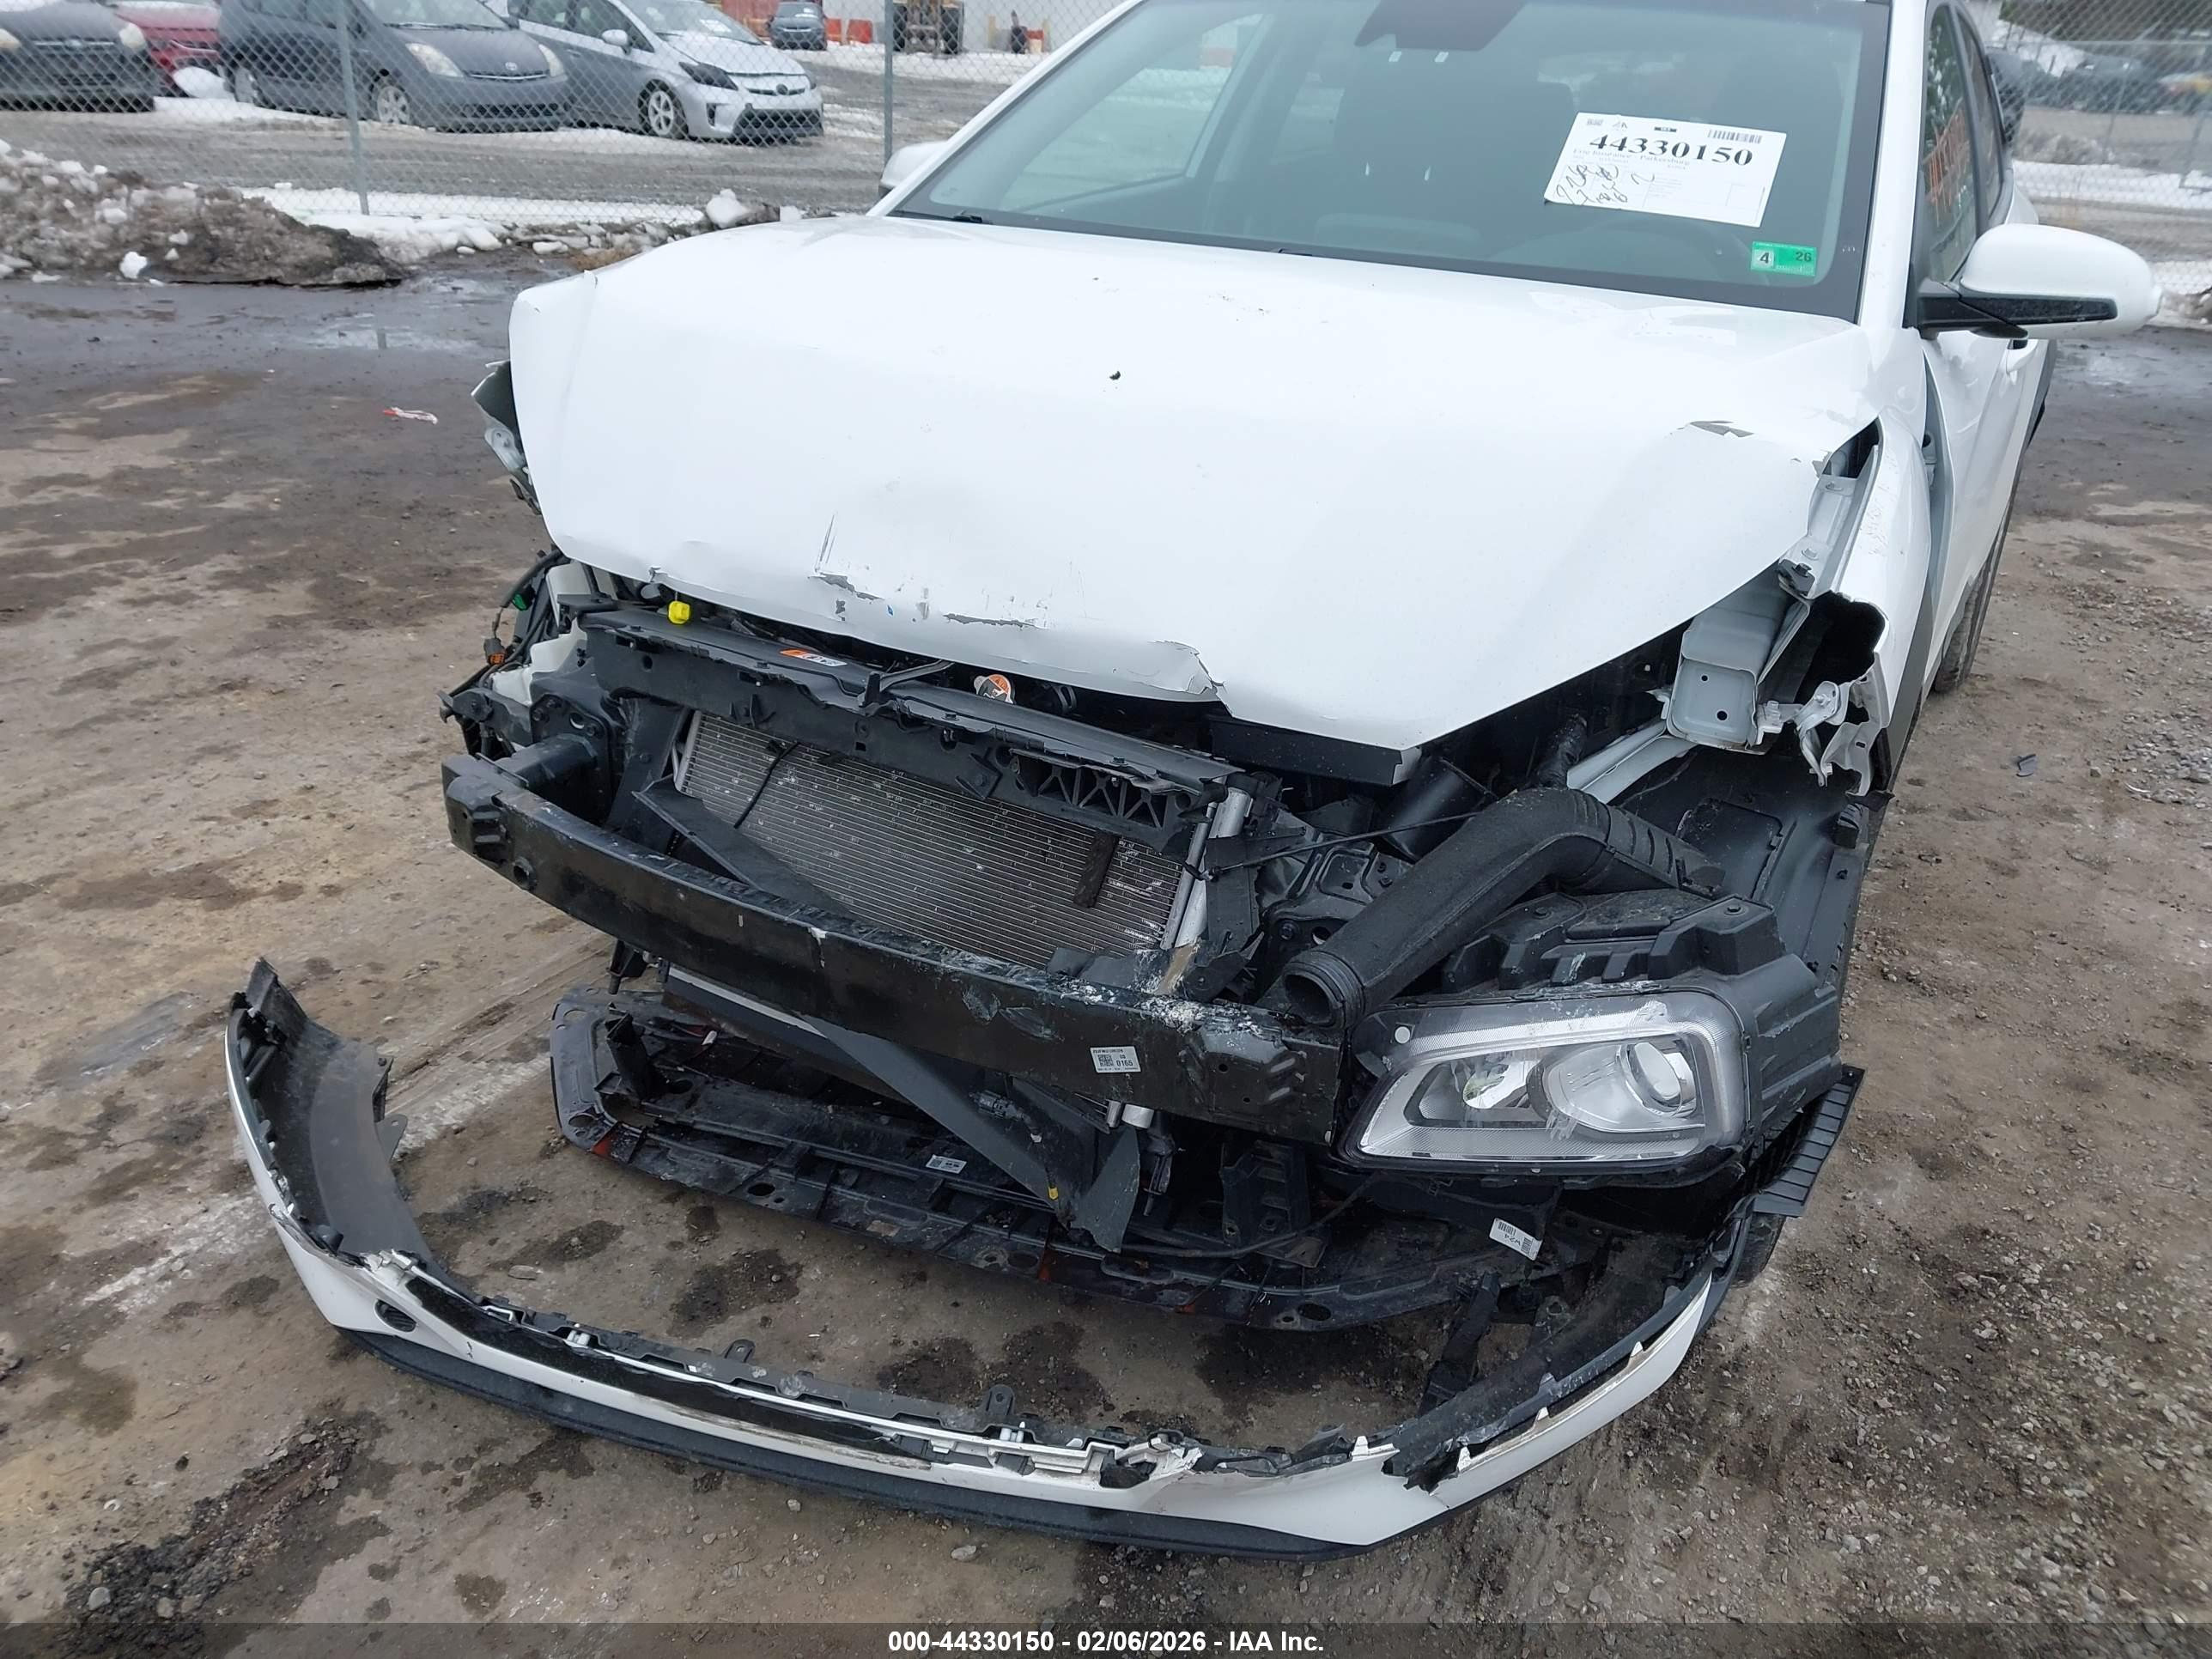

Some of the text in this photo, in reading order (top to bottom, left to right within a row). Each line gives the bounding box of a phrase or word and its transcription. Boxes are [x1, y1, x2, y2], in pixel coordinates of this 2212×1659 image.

[1589, 133, 1753, 166] 44330150
[1759, 252, 1812, 264] 4 26
